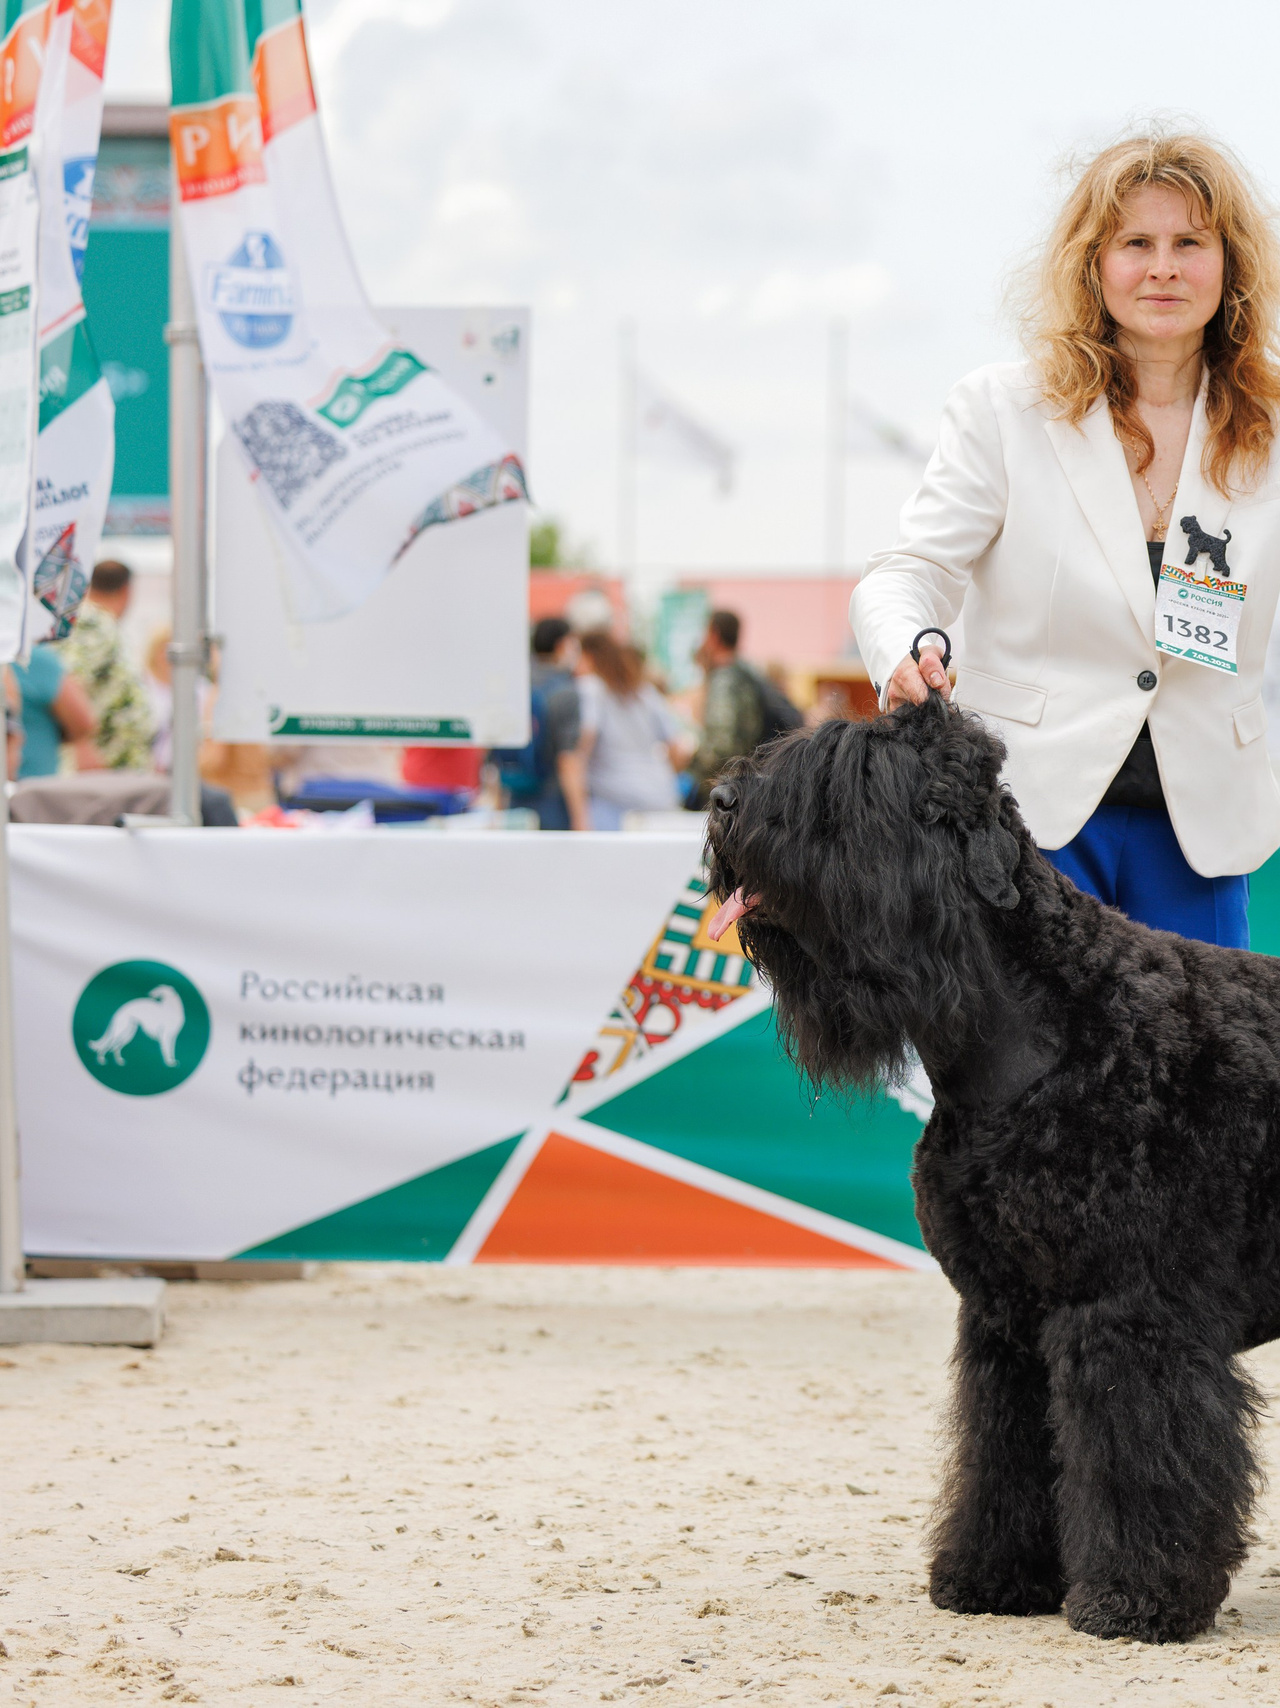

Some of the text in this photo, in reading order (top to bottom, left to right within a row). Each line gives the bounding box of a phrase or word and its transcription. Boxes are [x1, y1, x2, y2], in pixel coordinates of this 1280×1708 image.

[1190, 593, 1223, 608] РОССИЯ
[1163, 614, 1228, 652] 1382
[239, 970, 445, 1004] Российская
[238, 1021, 527, 1051] кинологическая
[237, 1057, 435, 1097] федерация
